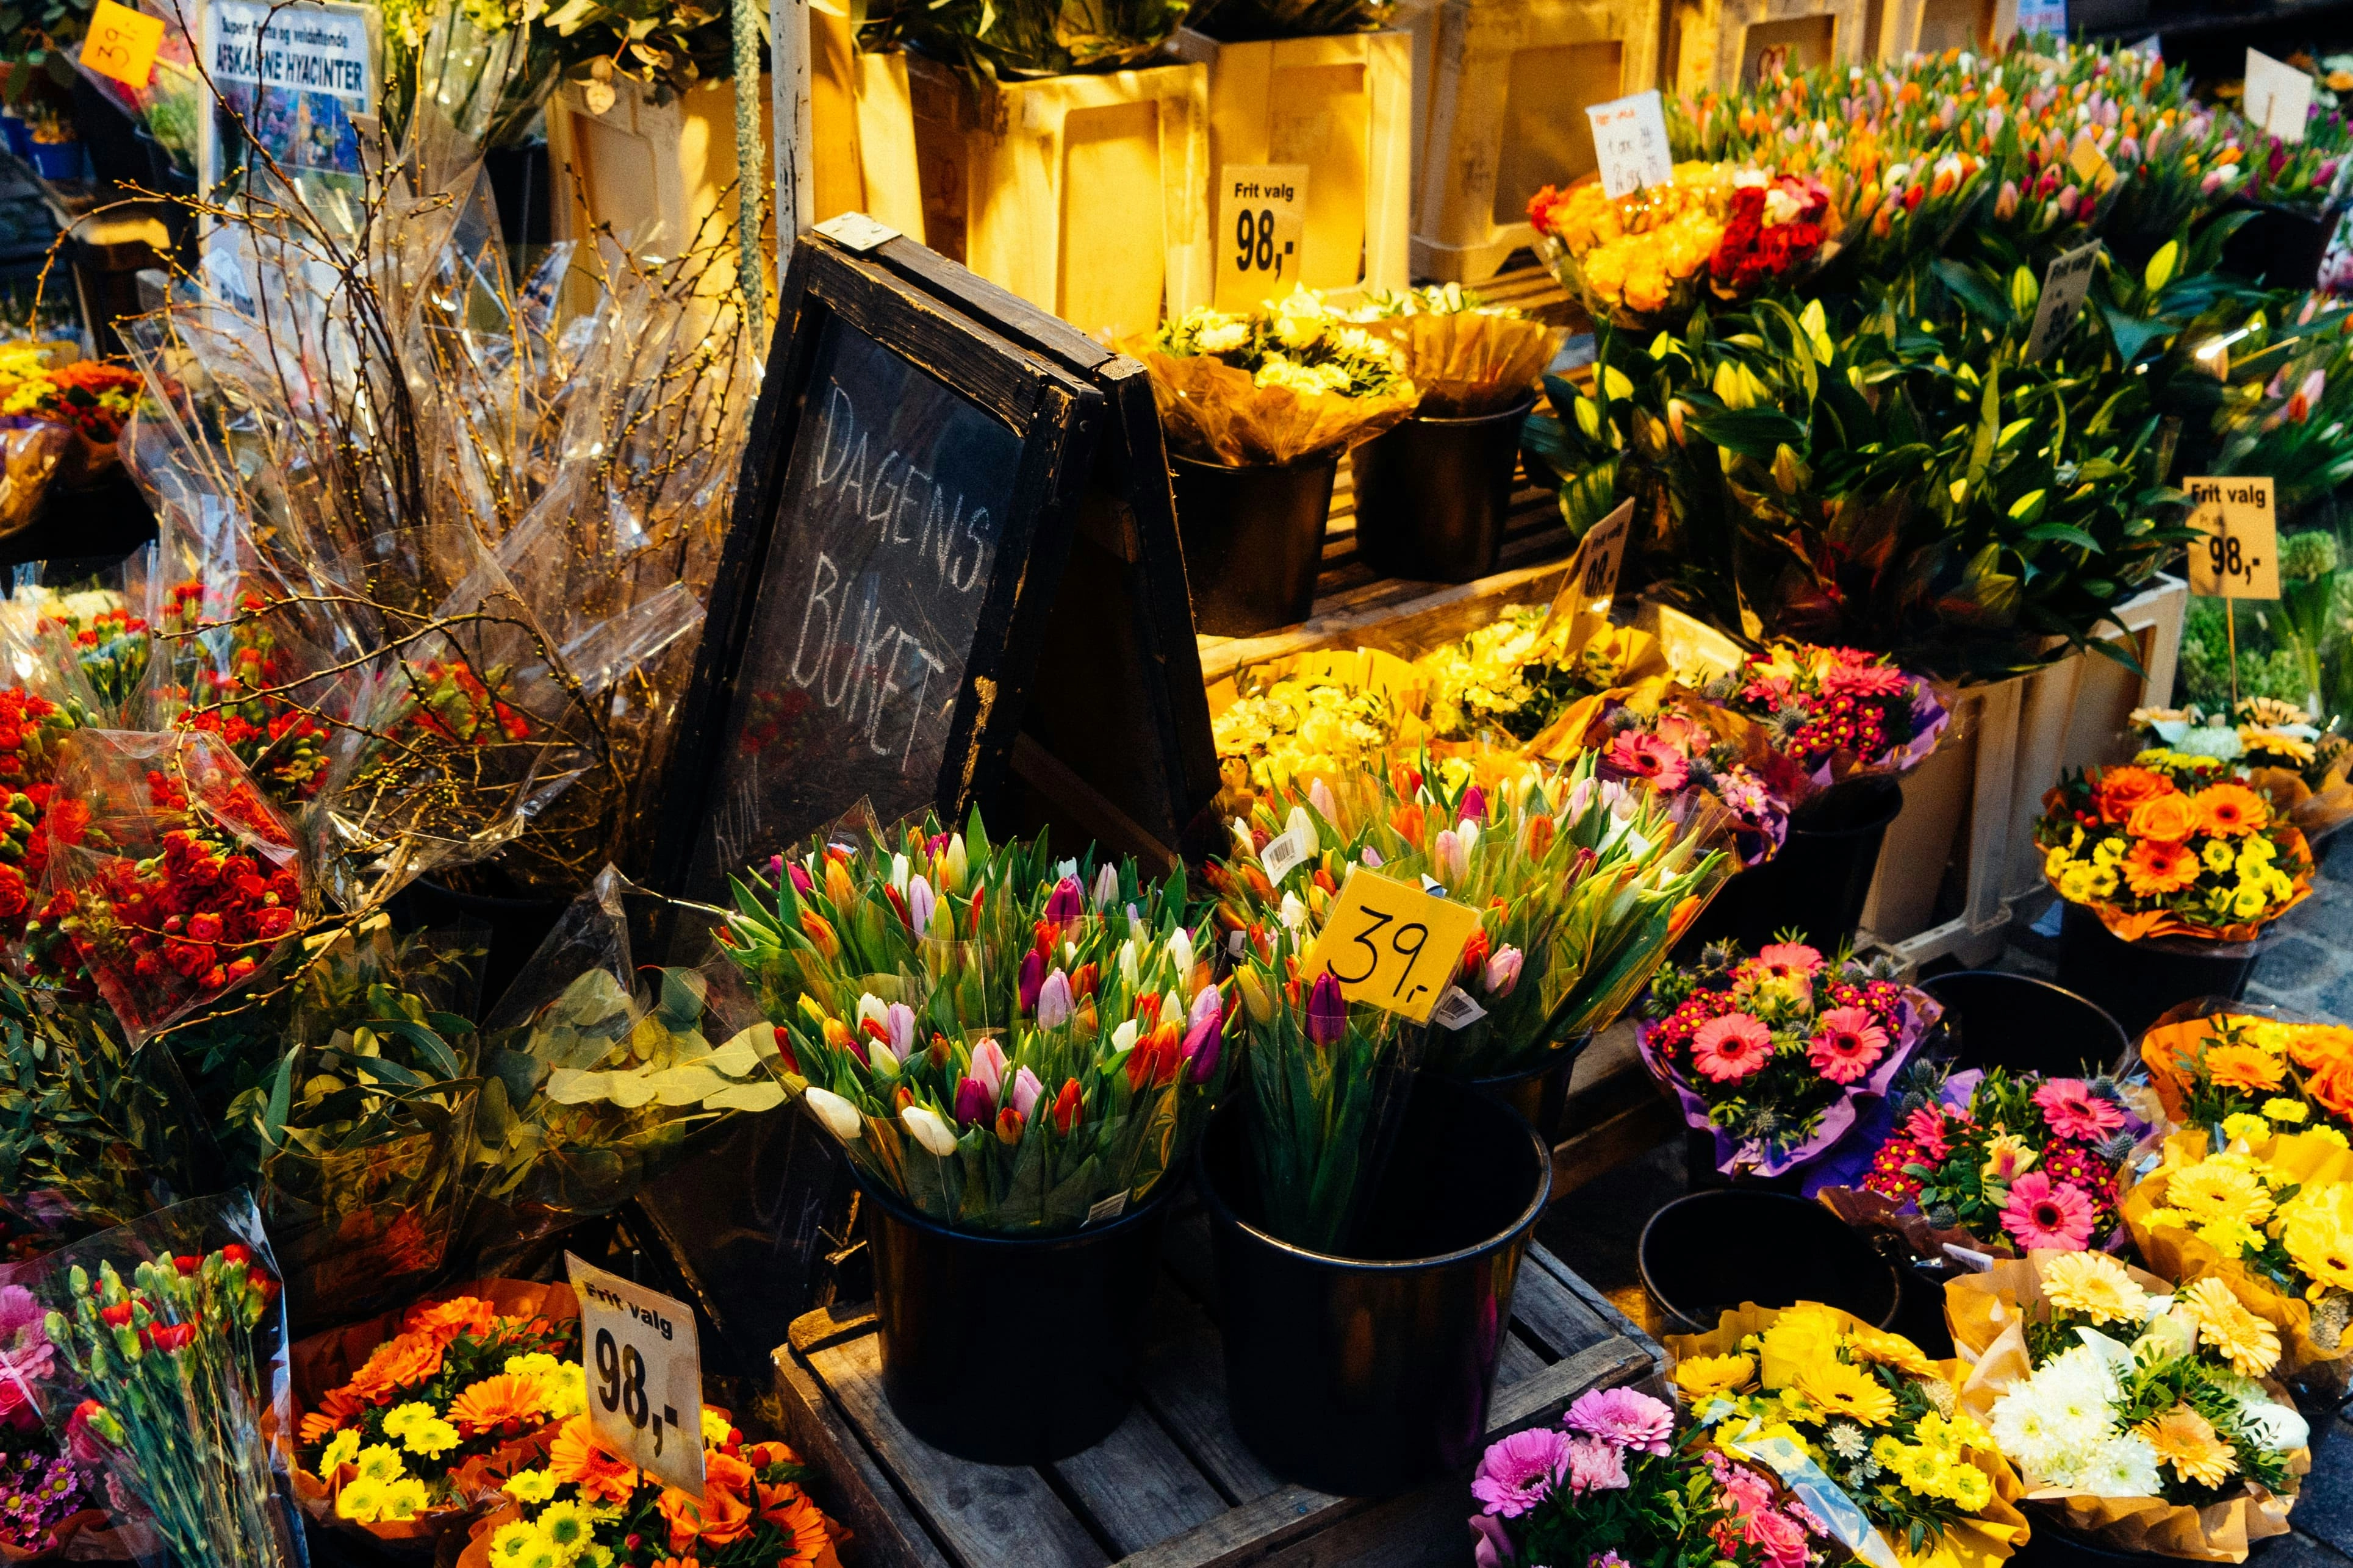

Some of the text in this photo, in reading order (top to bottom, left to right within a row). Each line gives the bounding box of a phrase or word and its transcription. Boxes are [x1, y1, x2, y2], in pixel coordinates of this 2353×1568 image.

[286, 52, 363, 91] HYACINTER
[1234, 182, 1294, 202] Frit valg
[1236, 209, 1294, 283] 98,-
[816, 387, 990, 593] DAGENS
[2191, 484, 2265, 508] Frit valg
[2210, 536, 2260, 585] 98,-
[792, 551, 946, 773] BUKET
[583, 1280, 673, 1341] Frit valg
[595, 1327, 678, 1458] 98,-
